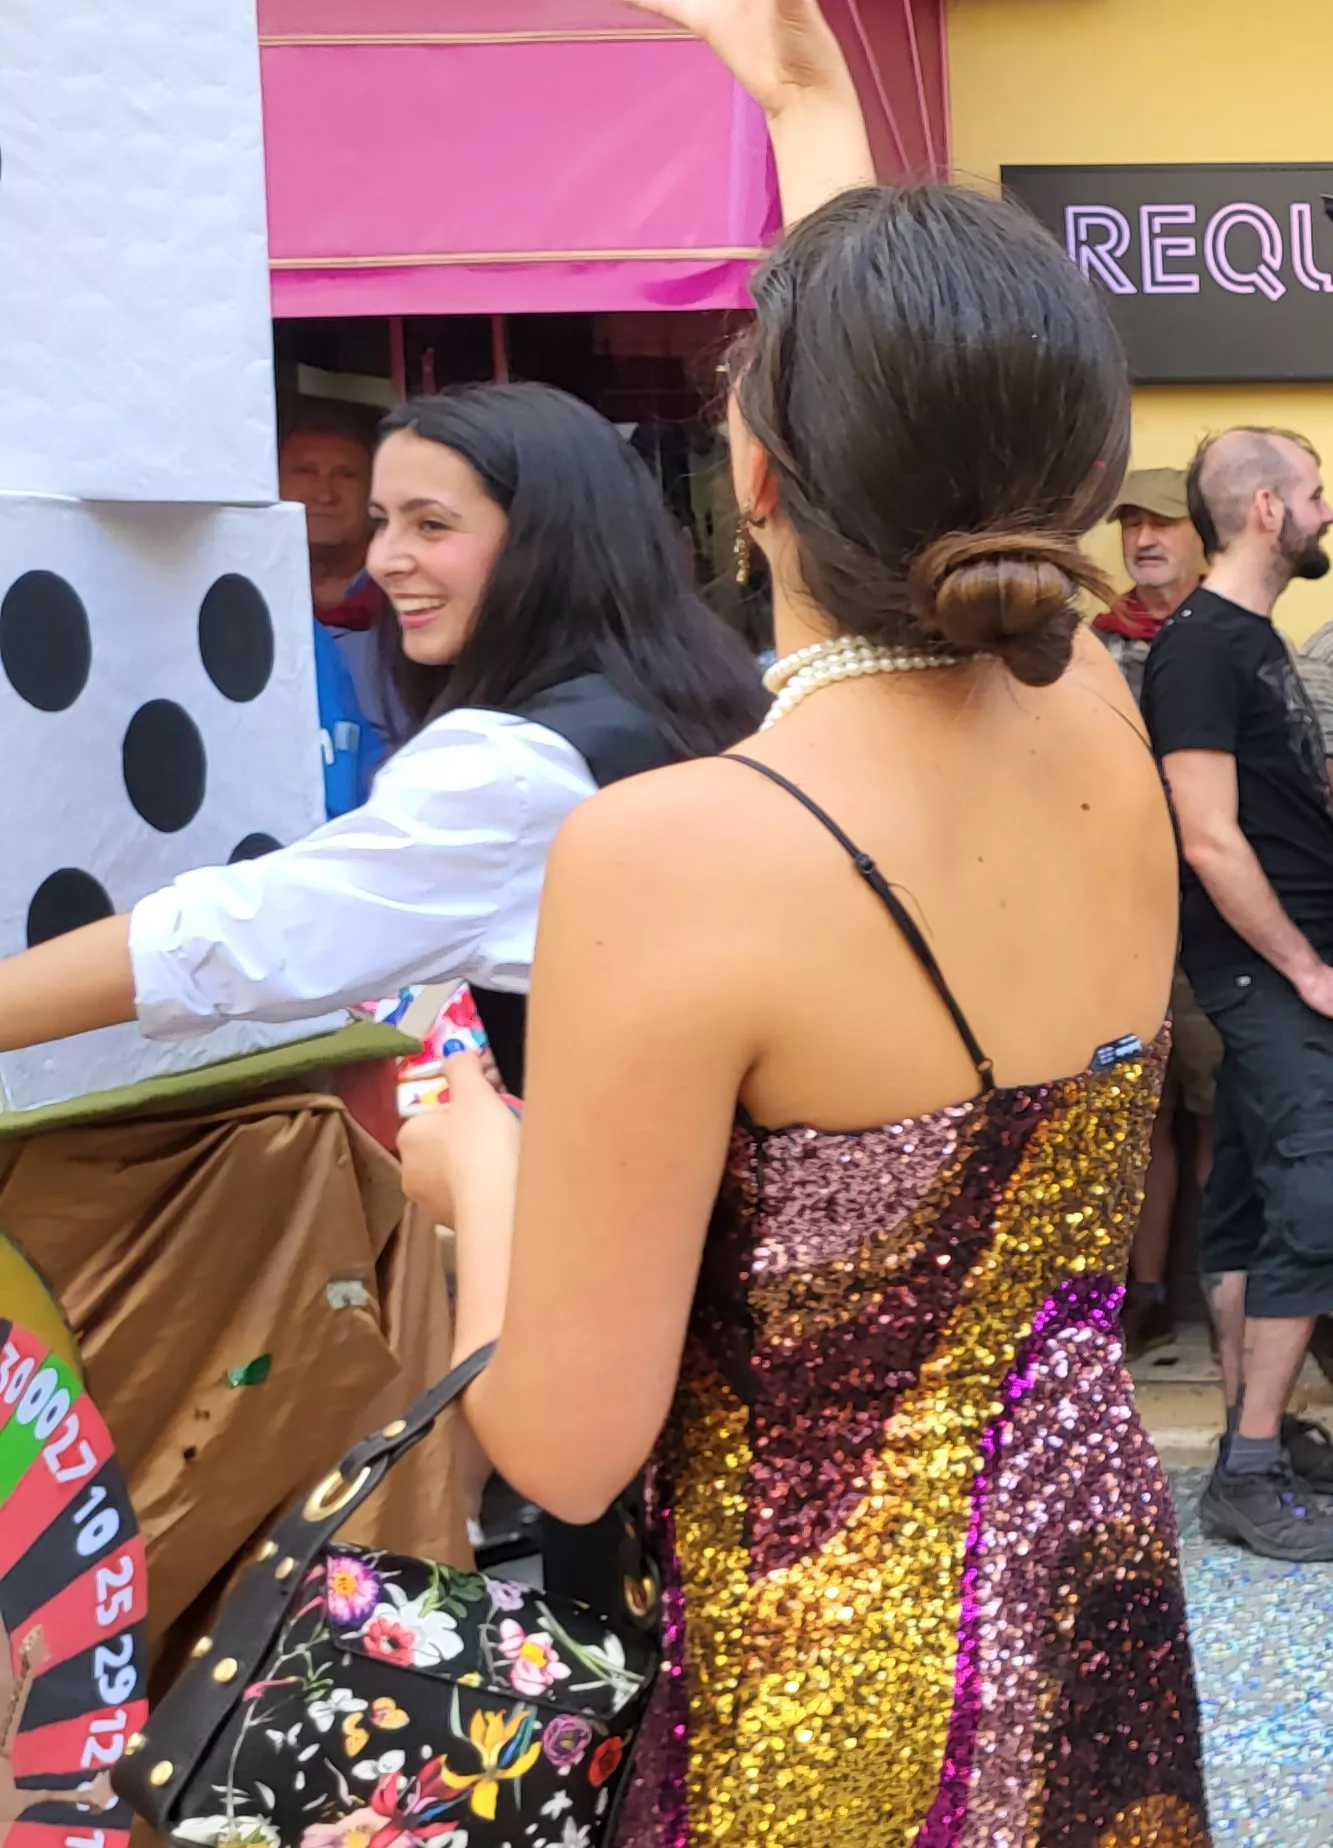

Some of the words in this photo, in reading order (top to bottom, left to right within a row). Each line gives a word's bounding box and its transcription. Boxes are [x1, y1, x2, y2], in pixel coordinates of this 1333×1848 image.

[16, 1366, 71, 1441] 00
[42, 1412, 98, 1484] 27
[73, 1485, 120, 1557] 10
[95, 1555, 135, 1626] 25
[94, 1633, 137, 1705] 29
[80, 1708, 128, 1768] 12
